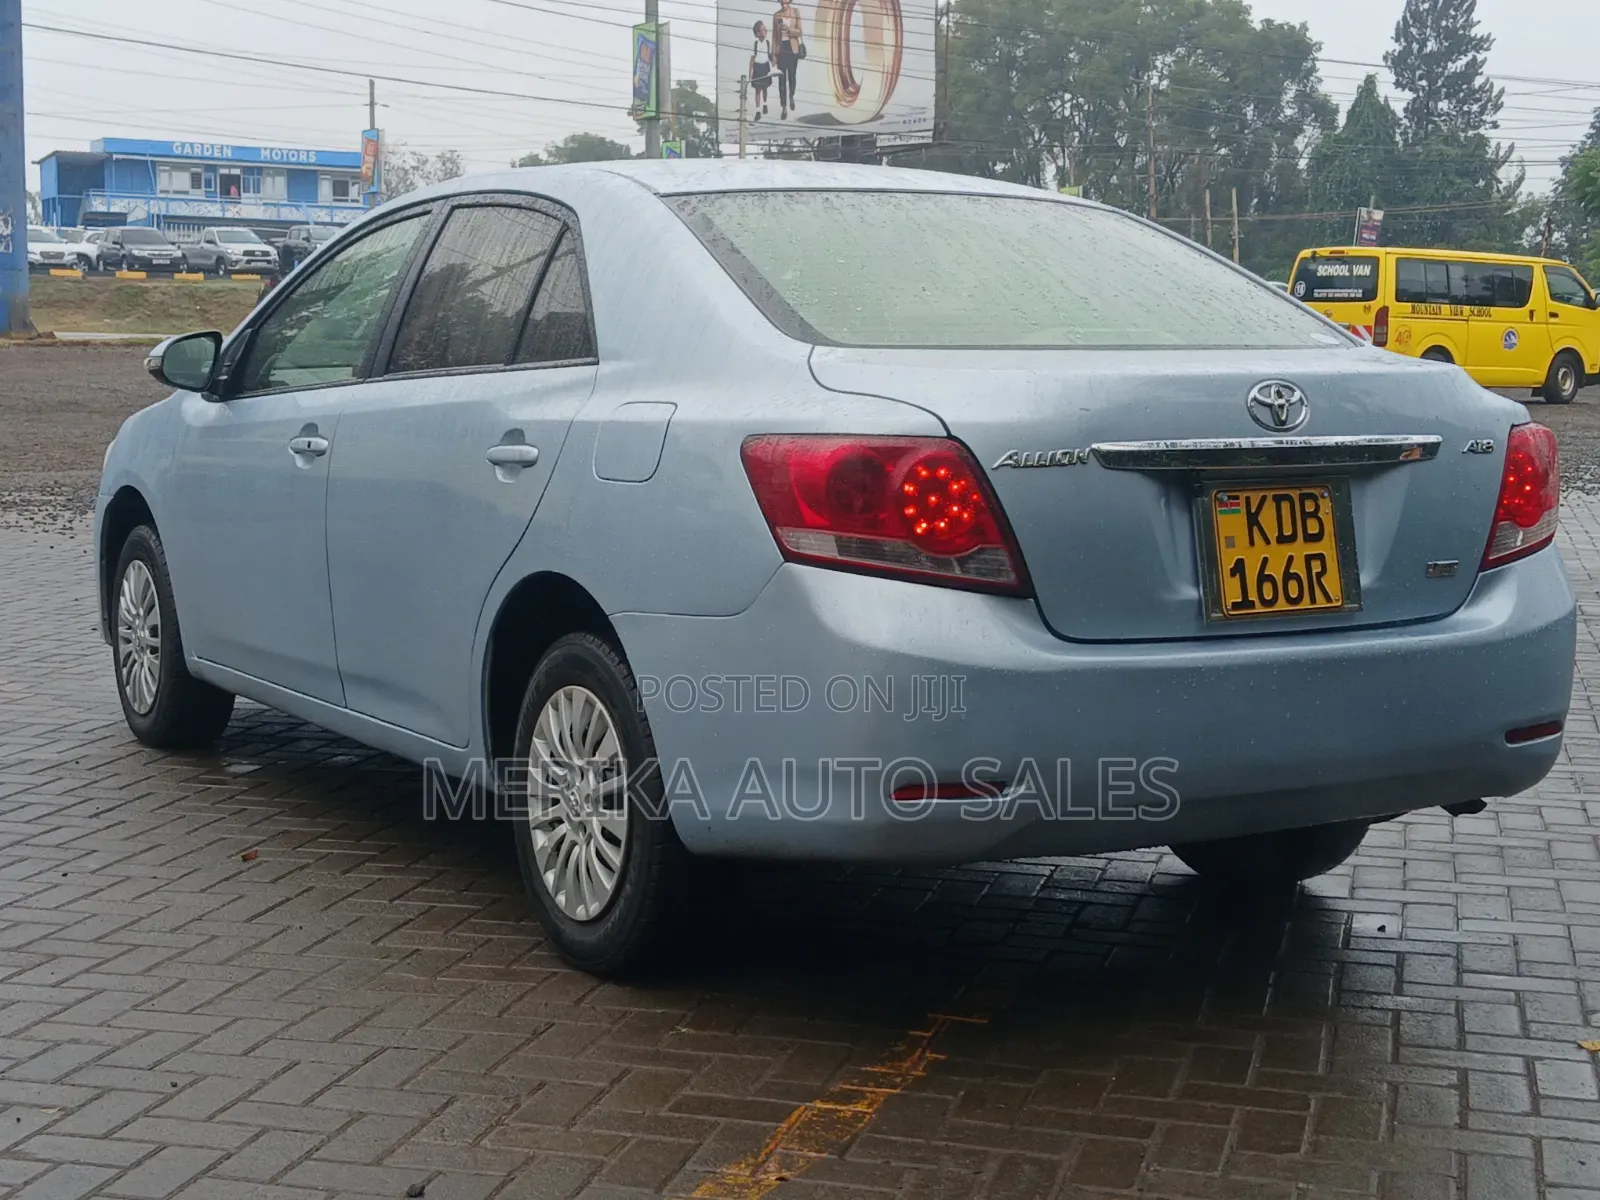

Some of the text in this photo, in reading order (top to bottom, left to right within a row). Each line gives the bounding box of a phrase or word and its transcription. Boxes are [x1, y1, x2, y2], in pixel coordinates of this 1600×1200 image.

[172, 142, 317, 163] GARDEN MOTORS
[1316, 264, 1372, 277] SCHOOL VAN
[1410, 303, 1442, 316] MOUNTAIN
[1469, 306, 1492, 318] SCHOOL
[991, 448, 1091, 471] ALLION
[1244, 492, 1325, 547] KDB
[1229, 551, 1334, 611] 166R
